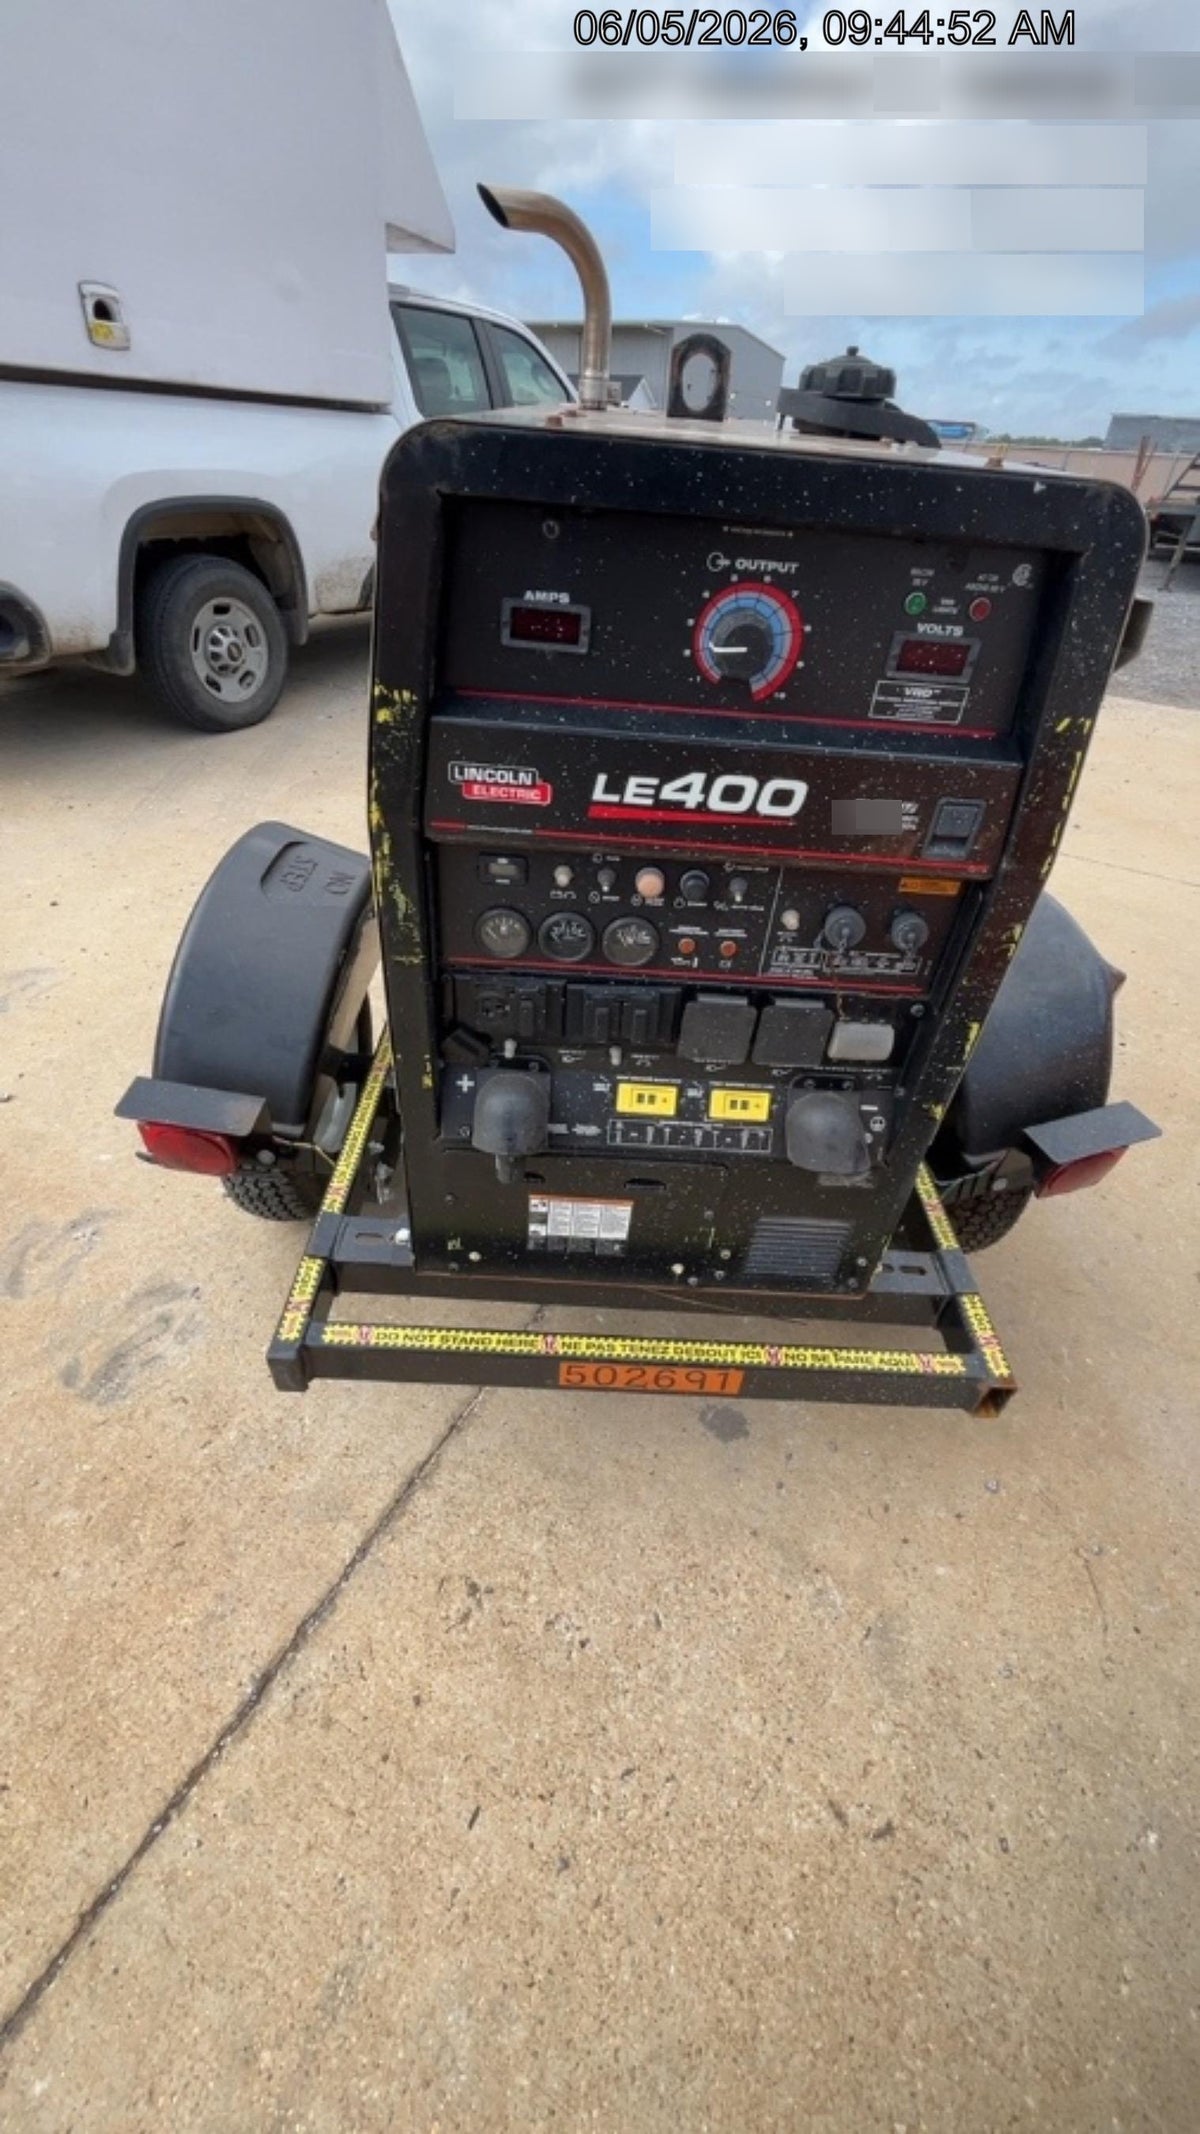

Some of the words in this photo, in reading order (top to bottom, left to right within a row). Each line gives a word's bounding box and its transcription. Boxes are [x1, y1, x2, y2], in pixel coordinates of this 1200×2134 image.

[735, 558, 800, 574] OUTPUT
[523, 589, 571, 604] AMPS
[917, 622, 965, 638] VOLTS
[454, 765, 533, 787] LINCOLN
[473, 785, 543, 802] ELECTRIC
[591, 771, 810, 818] LE400
[278, 855, 320, 894] STEP
[323, 868, 357, 896] NO
[376, 1331, 400, 1341] DO
[402, 1333, 437, 1343] NOT
[440, 1334, 492, 1346] STAND
[496, 1337, 539, 1348] HERE
[561, 1341, 581, 1351] NE
[784, 1352, 807, 1362] NO
[563, 1364, 731, 1391] 502691
